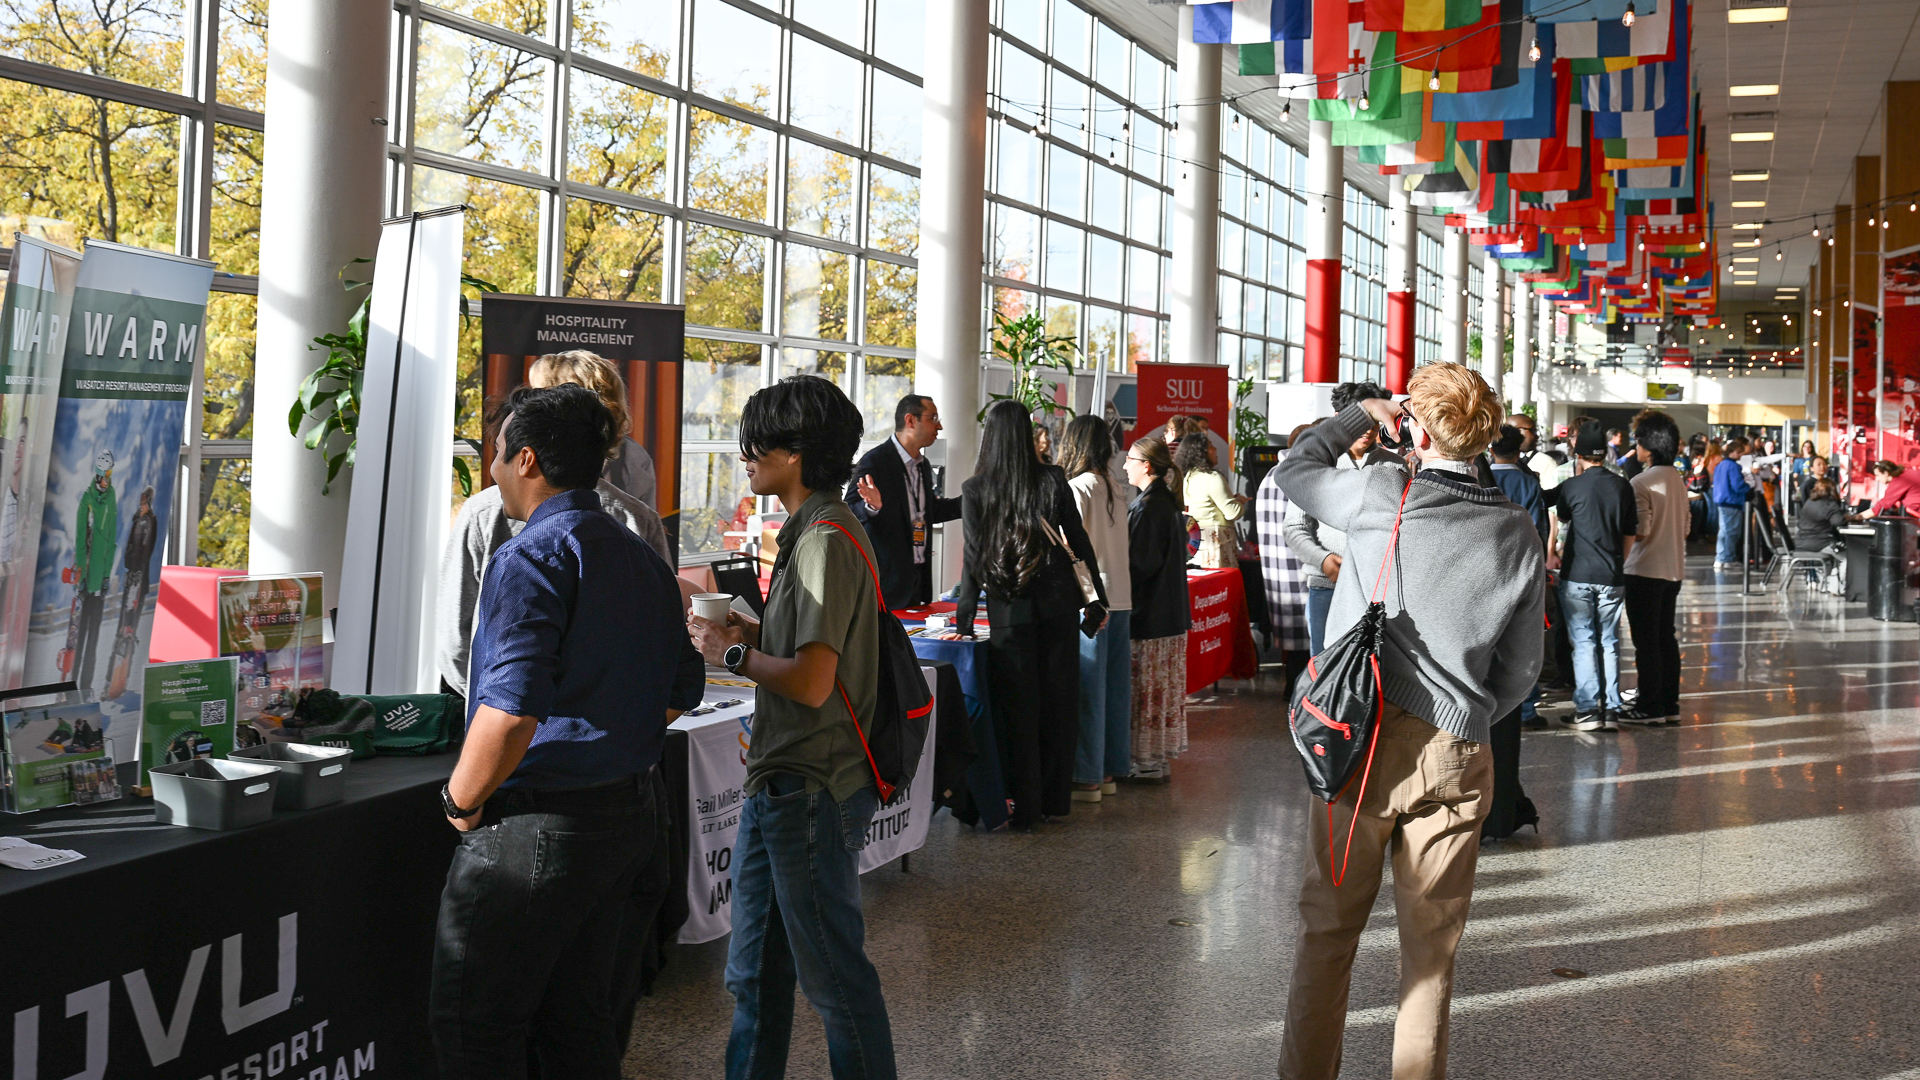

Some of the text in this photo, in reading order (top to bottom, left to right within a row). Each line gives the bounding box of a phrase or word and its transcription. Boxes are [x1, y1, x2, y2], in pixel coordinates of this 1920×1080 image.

[545, 314, 627, 329] HOSPITALITY
[83, 311, 198, 363] WARM
[537, 330, 634, 346] MANAGEMENT
[76, 379, 105, 390] WASATCH
[105, 380, 128, 391] RESORT
[128, 382, 165, 393] MANAGEMENT
[1166, 378, 1204, 399] SUU
[1156, 405, 1179, 413] School
[1184, 406, 1213, 414] Business
[268, 589, 300, 599] FUTURE
[1194, 591, 1223, 612] Department
[243, 613, 301, 625] STARTS HERE
[161, 677, 202, 687] Hospitality
[161, 684, 209, 695] Management
[383, 702, 414, 722] UVU
[718, 788, 741, 810] Miller
[701, 815, 738, 835] LT LAKE
[862, 807, 911, 850] STITUT
[706, 847, 732, 878] HO
[13, 912, 299, 1080] UVU
[197, 1019, 329, 1080] ESORT
